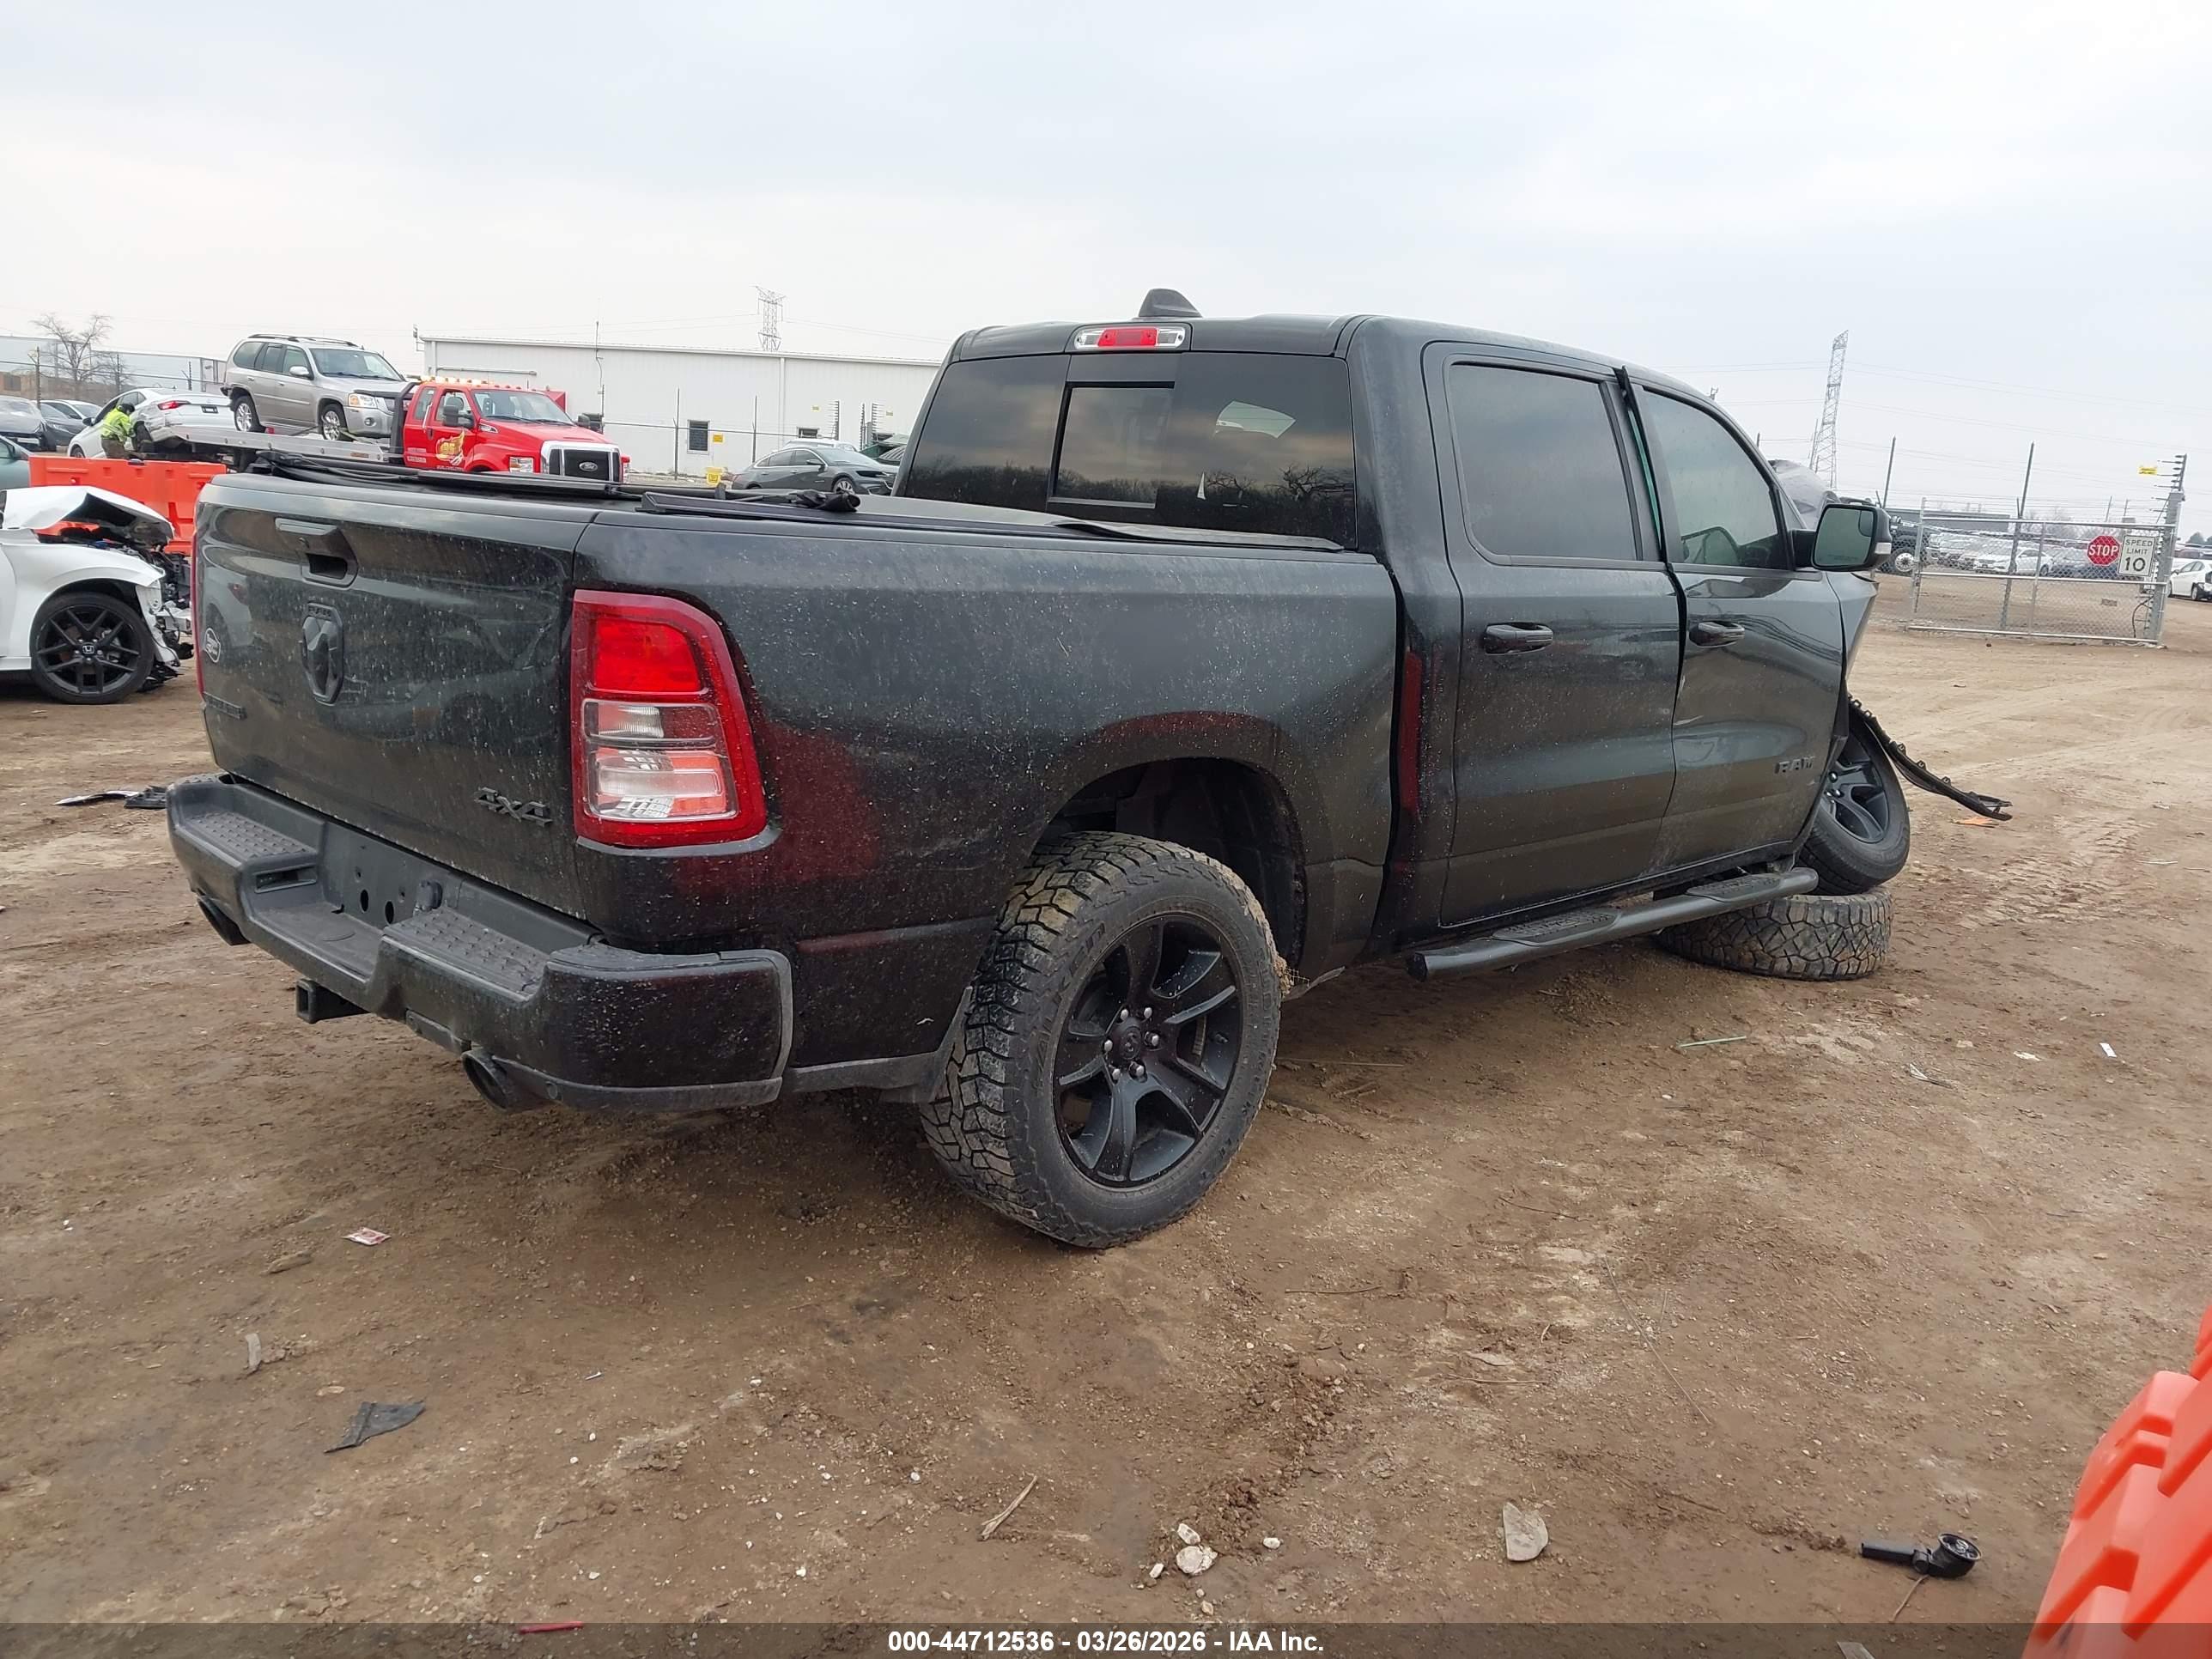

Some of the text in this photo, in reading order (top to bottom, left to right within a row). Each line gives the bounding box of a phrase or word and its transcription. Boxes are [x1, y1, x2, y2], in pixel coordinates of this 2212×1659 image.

[2088, 544, 2118, 556] STOP
[2124, 556, 2146, 572] 10
[1774, 757, 1815, 774] RAM
